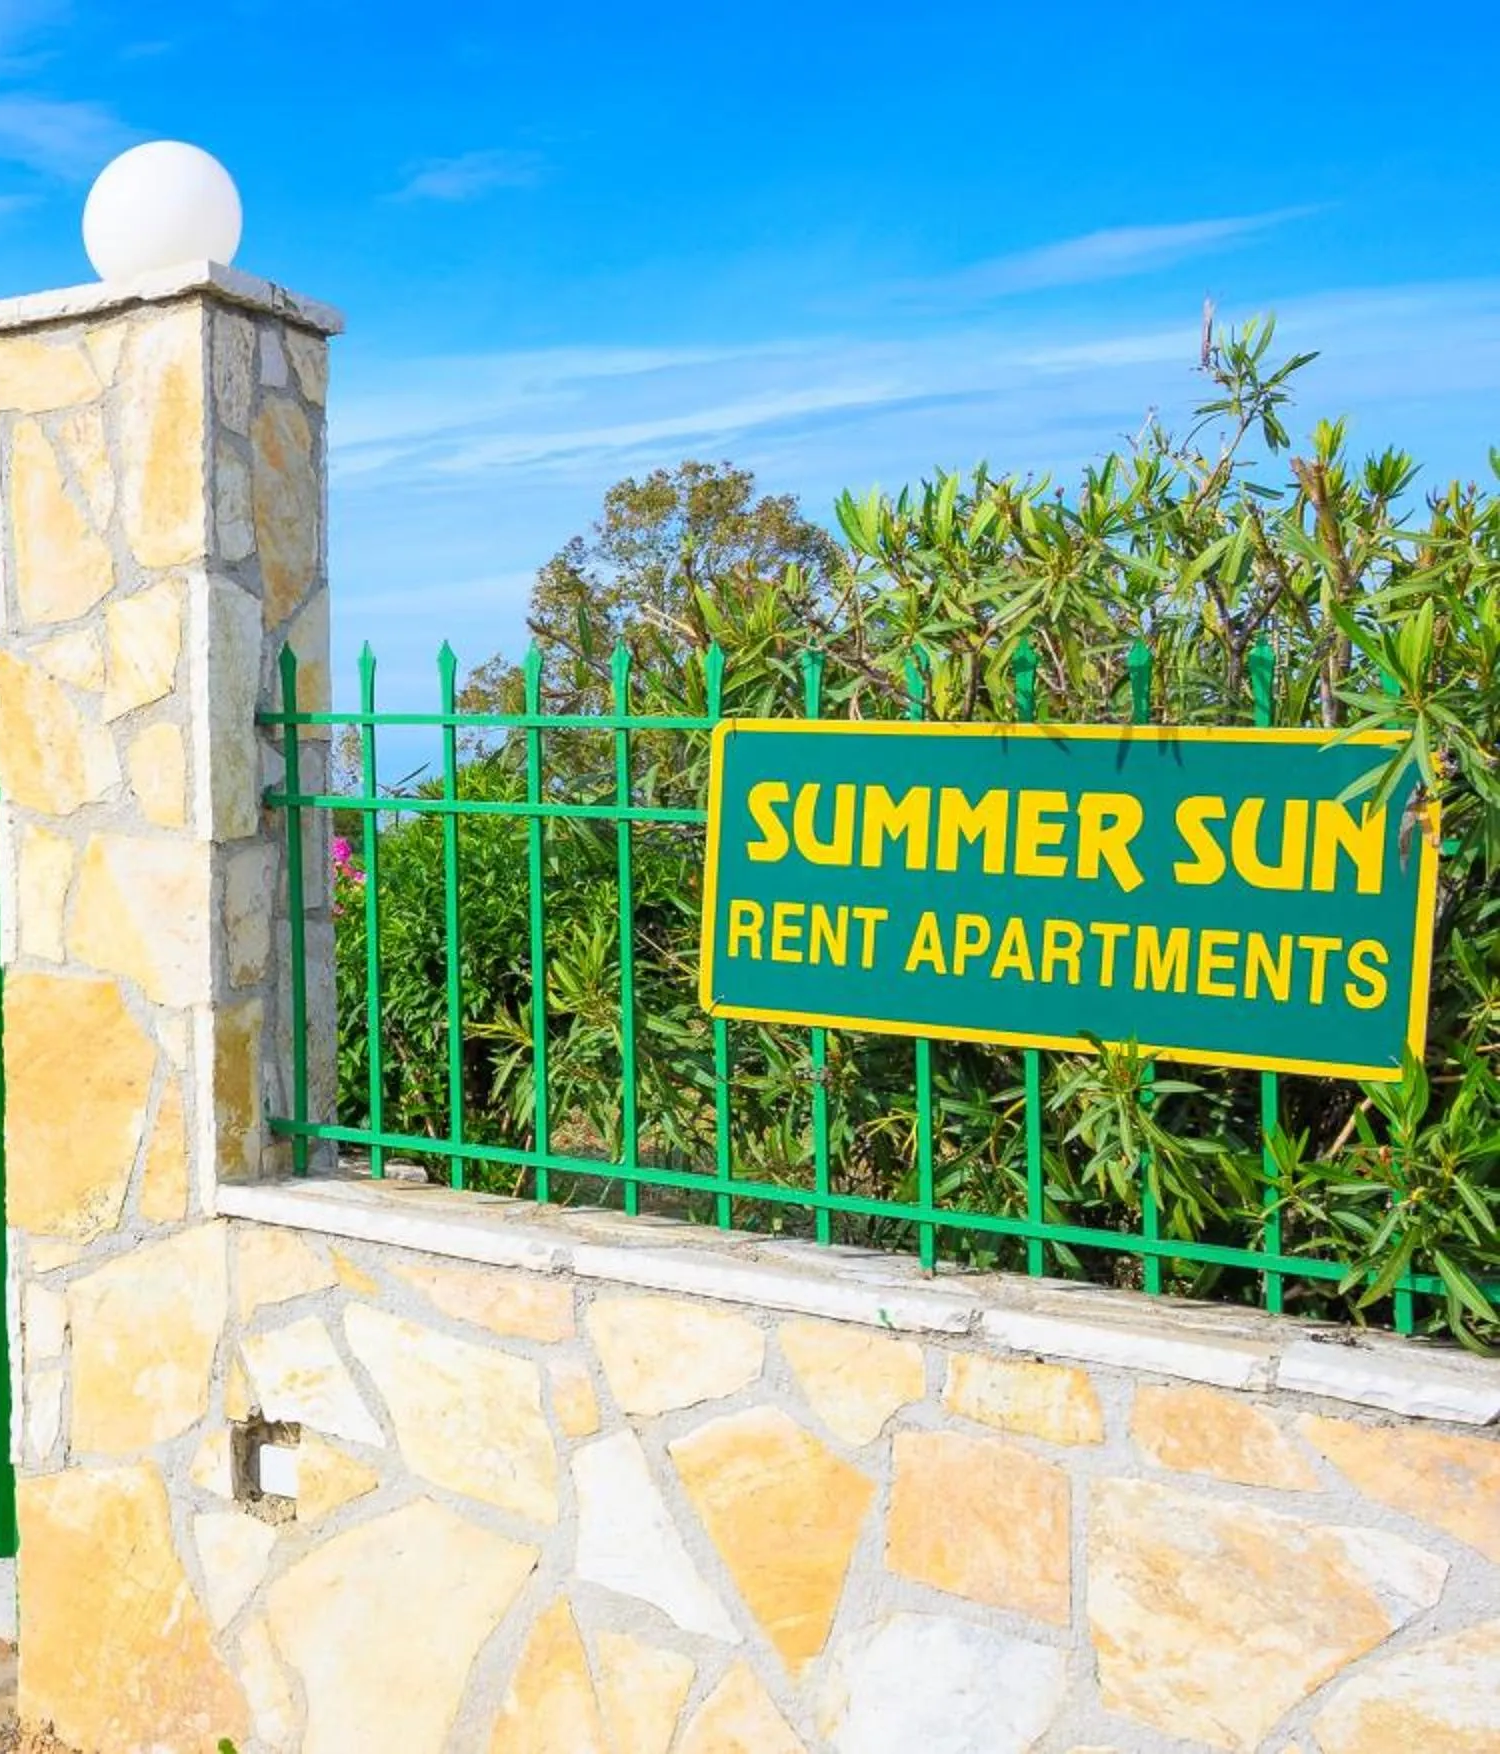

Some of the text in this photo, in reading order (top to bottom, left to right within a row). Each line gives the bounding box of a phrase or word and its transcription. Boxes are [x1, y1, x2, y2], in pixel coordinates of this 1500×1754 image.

[746, 781, 1387, 895] SUMMER SUN
[727, 899, 1389, 1009] RENT APARTMENTS
